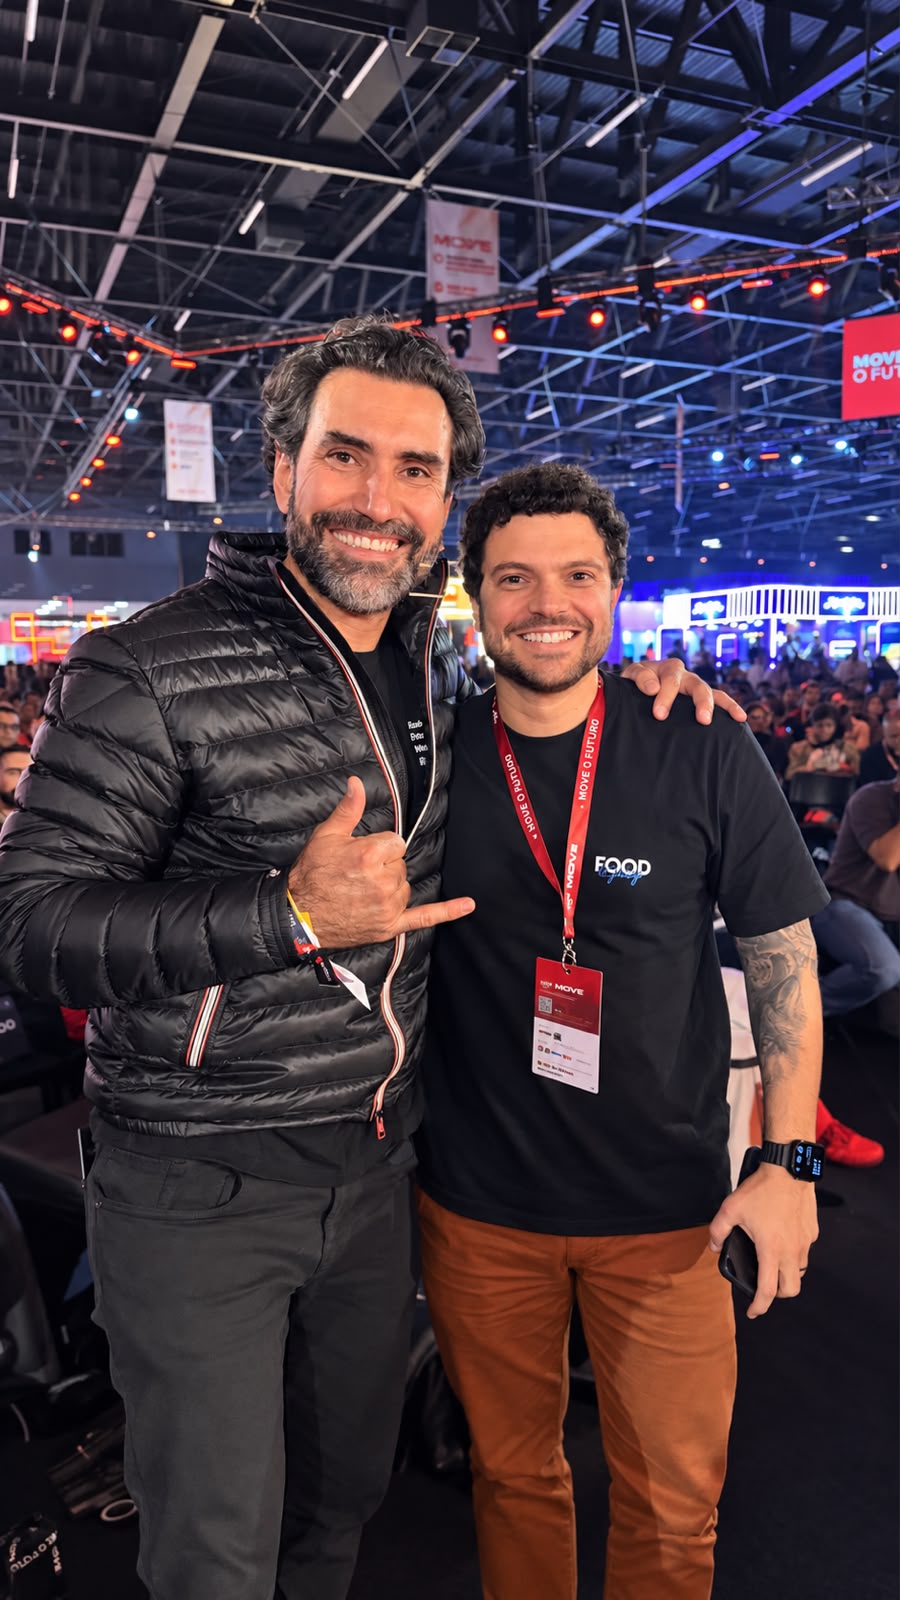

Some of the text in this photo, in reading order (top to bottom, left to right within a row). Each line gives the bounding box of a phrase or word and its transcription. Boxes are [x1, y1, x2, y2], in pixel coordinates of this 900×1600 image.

[853, 369, 867, 384] O
[578, 718, 600, 801] MOVE O FUTURO
[566, 844, 579, 888] MOVE
[594, 855, 652, 877] FOOD
[554, 983, 584, 995] MOVE
